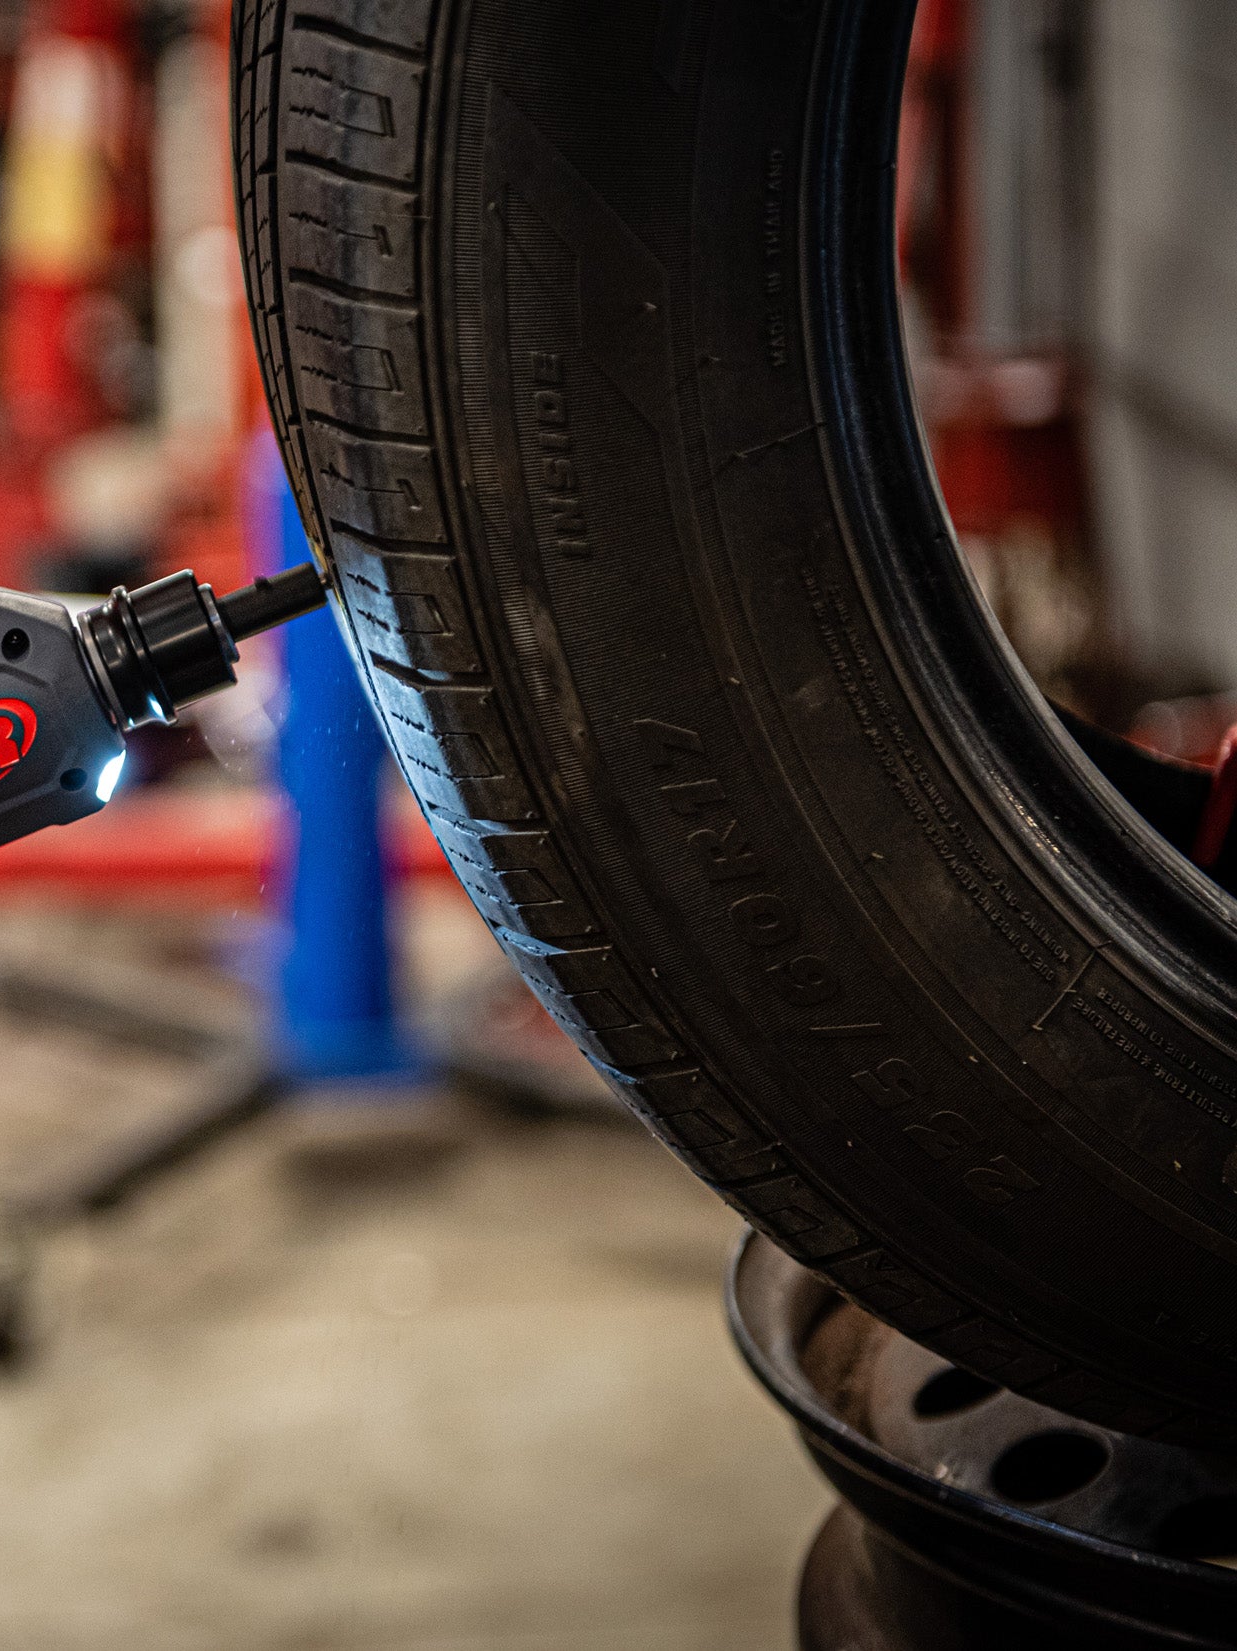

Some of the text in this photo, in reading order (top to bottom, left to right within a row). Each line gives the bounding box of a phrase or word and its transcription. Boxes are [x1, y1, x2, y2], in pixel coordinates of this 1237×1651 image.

[531, 351, 591, 559] INSIDE
[634, 718, 1041, 1206] 235/60R17
[1016, 940, 1036, 960] TO
[1030, 955, 1057, 982] DUE
[1069, 995, 1121, 1041] FAILURE
[1093, 984, 1152, 1036] IMPROPER
[1146, 1028, 1166, 1047] TO
[1185, 1084, 1233, 1128] RESULT
